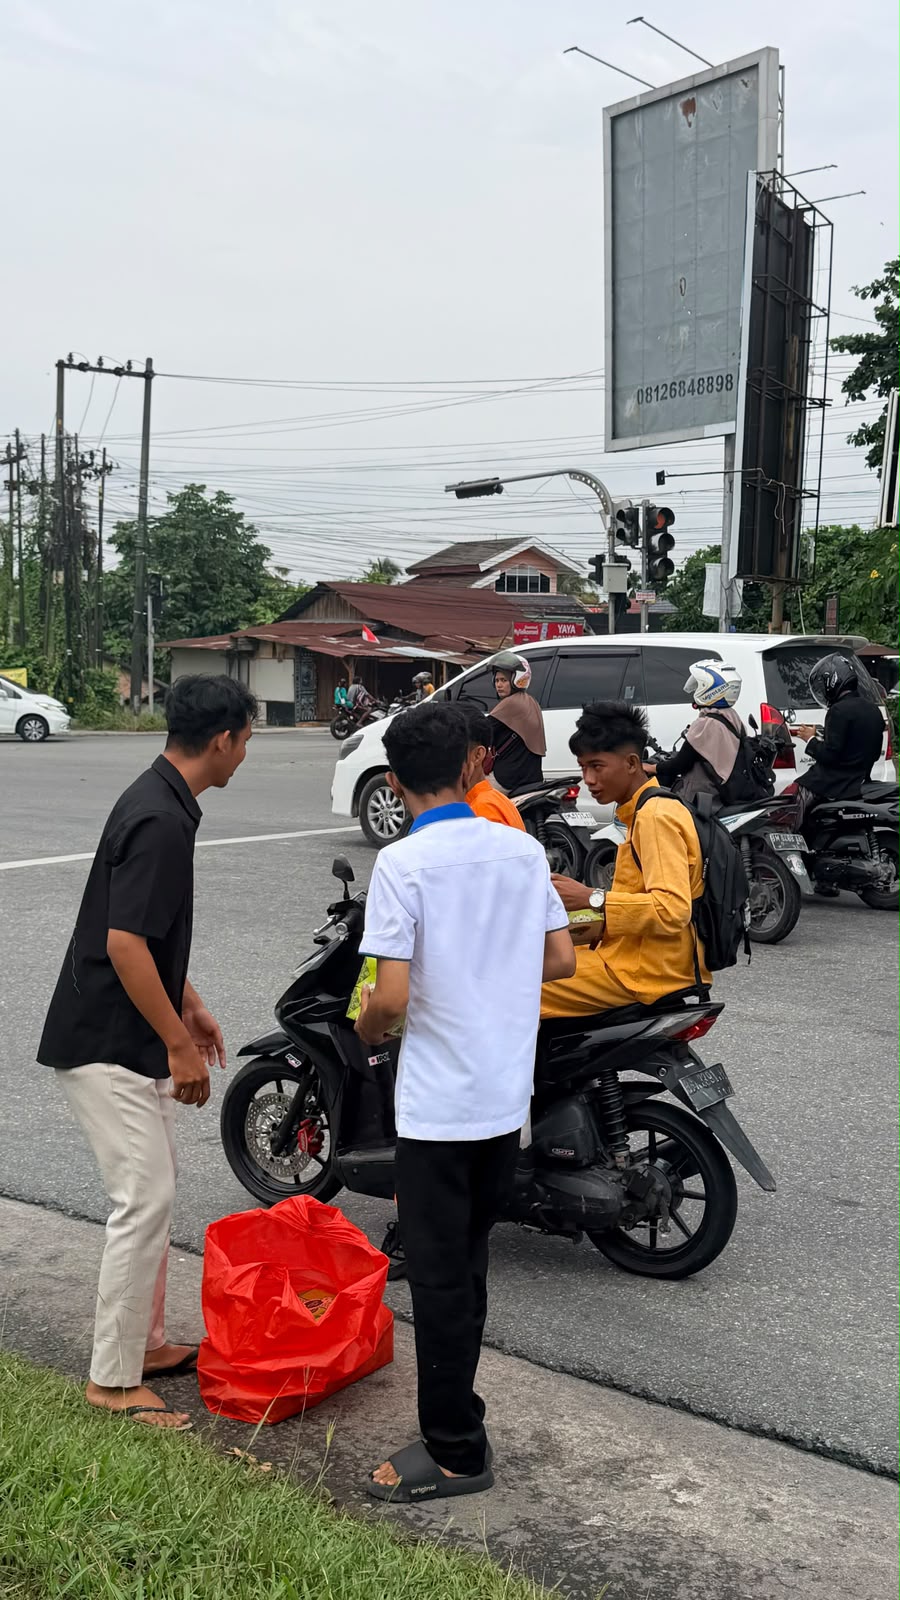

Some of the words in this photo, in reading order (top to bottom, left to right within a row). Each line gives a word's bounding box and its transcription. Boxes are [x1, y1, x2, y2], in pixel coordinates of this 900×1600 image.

[637, 373, 734, 405] 08126848898
[557, 623, 576, 634] YAYA
[411, 1483, 437, 1495] original
